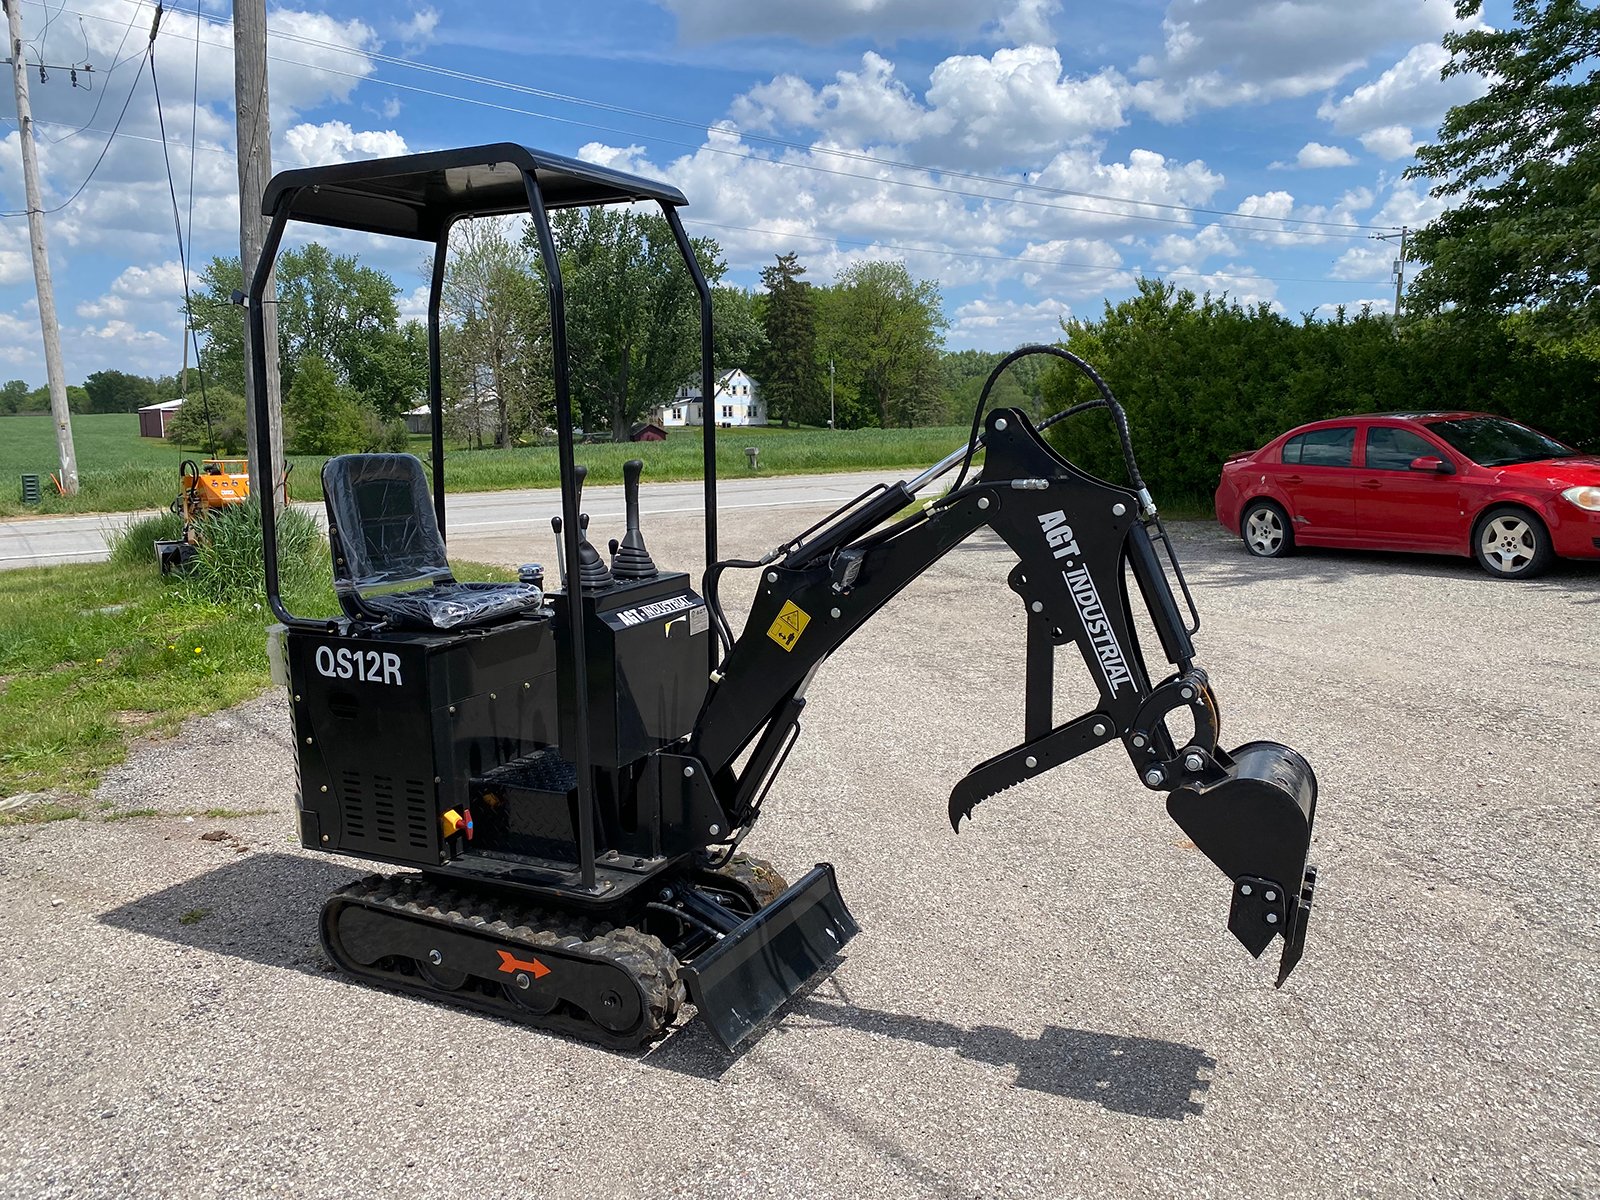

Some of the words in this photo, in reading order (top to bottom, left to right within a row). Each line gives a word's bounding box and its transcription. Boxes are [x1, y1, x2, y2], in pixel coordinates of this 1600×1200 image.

[616, 608, 645, 626] AGT
[641, 596, 693, 617] INDUSTRIAL
[1037, 509, 1081, 559] AGT
[1066, 568, 1131, 691] INDUSTRIAL
[315, 645, 403, 686] QS12R
